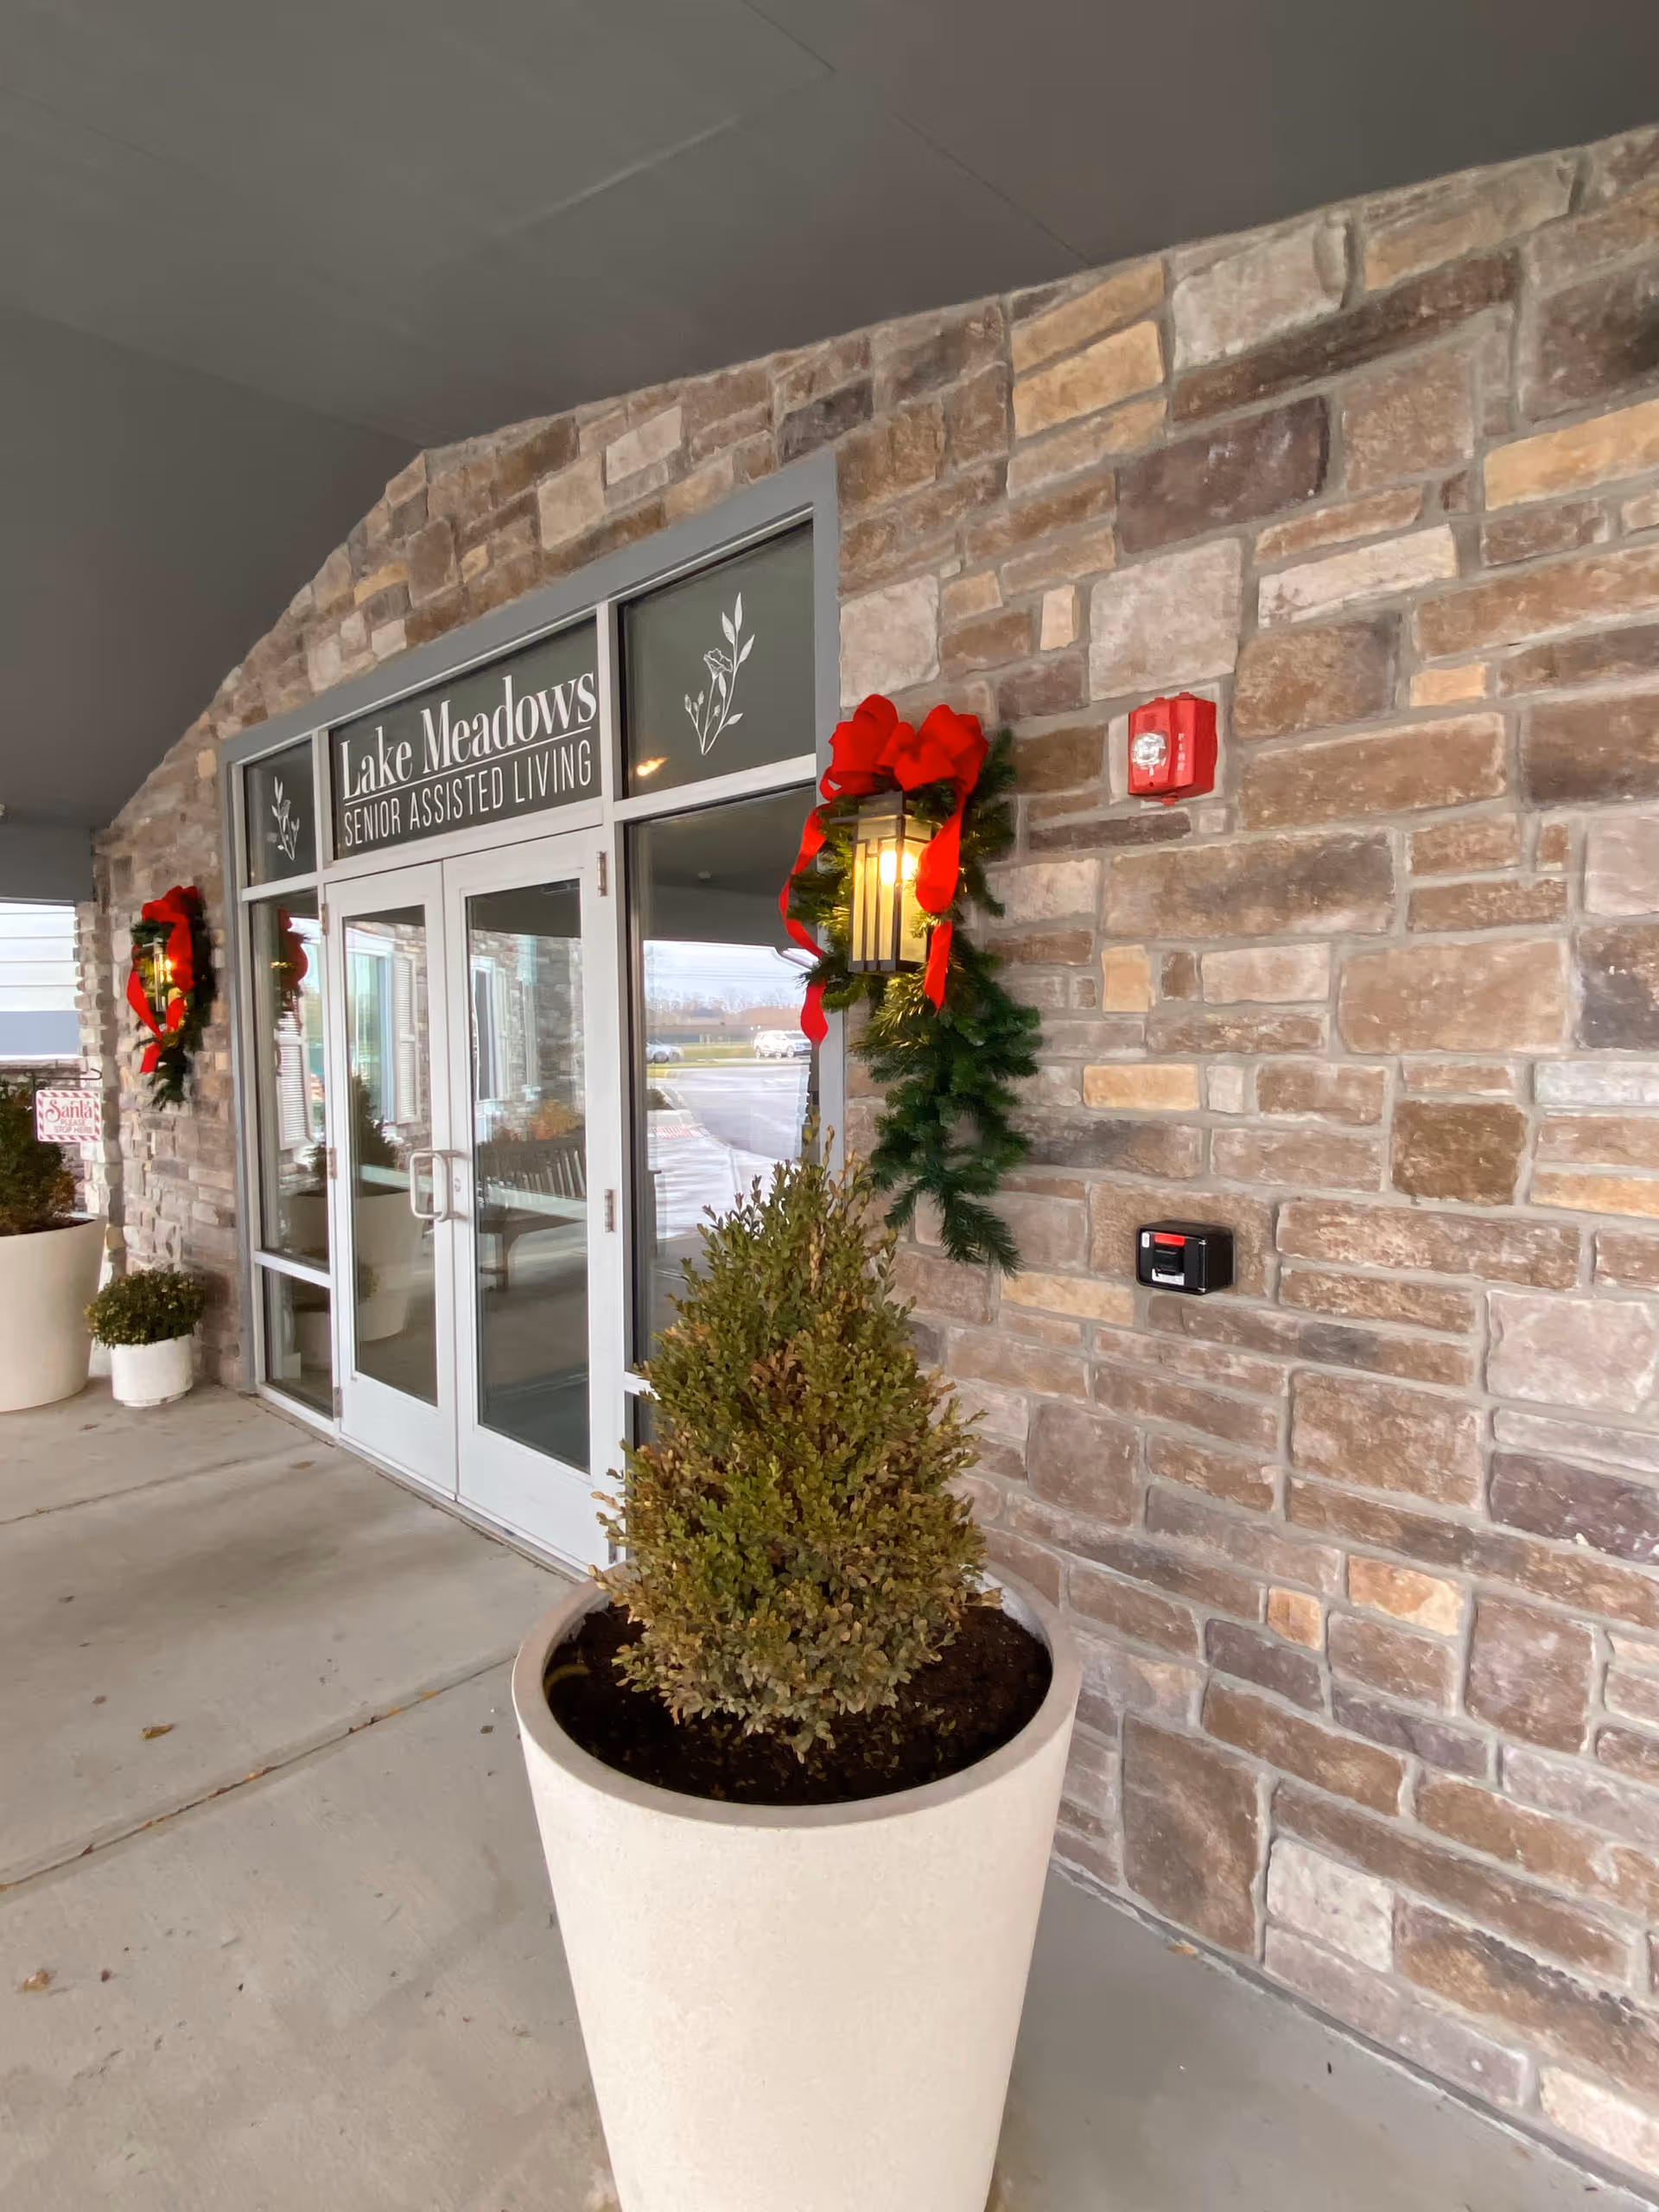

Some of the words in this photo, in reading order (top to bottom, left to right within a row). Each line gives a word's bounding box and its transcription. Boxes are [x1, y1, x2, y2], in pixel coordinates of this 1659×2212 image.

[340, 726, 413, 800] Lake
[420, 671, 597, 773] Meadows
[345, 798, 400, 847] SENIOR
[410, 766, 504, 830] ASSISTED
[514, 740, 592, 804] LIVING
[45, 1099, 92, 1122] Santa
